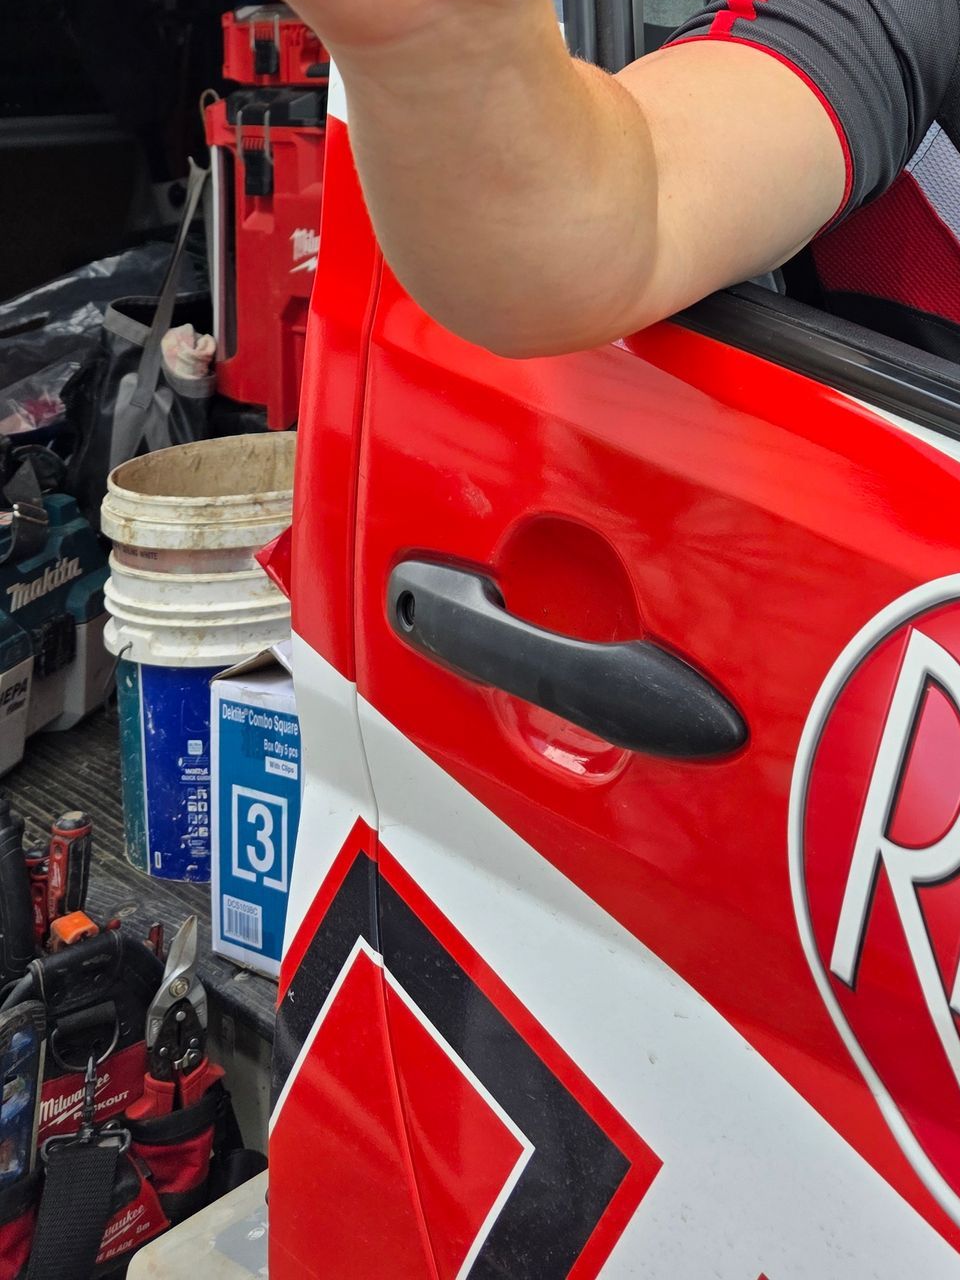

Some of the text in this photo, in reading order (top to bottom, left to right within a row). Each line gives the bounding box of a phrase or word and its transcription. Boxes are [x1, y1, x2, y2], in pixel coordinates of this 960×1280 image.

[248, 710, 273, 730] Combo
[273, 715, 298, 736] Square
[263, 738, 274, 751] Box
[288, 747, 298, 758] pcs
[246, 802, 275, 873] 3
